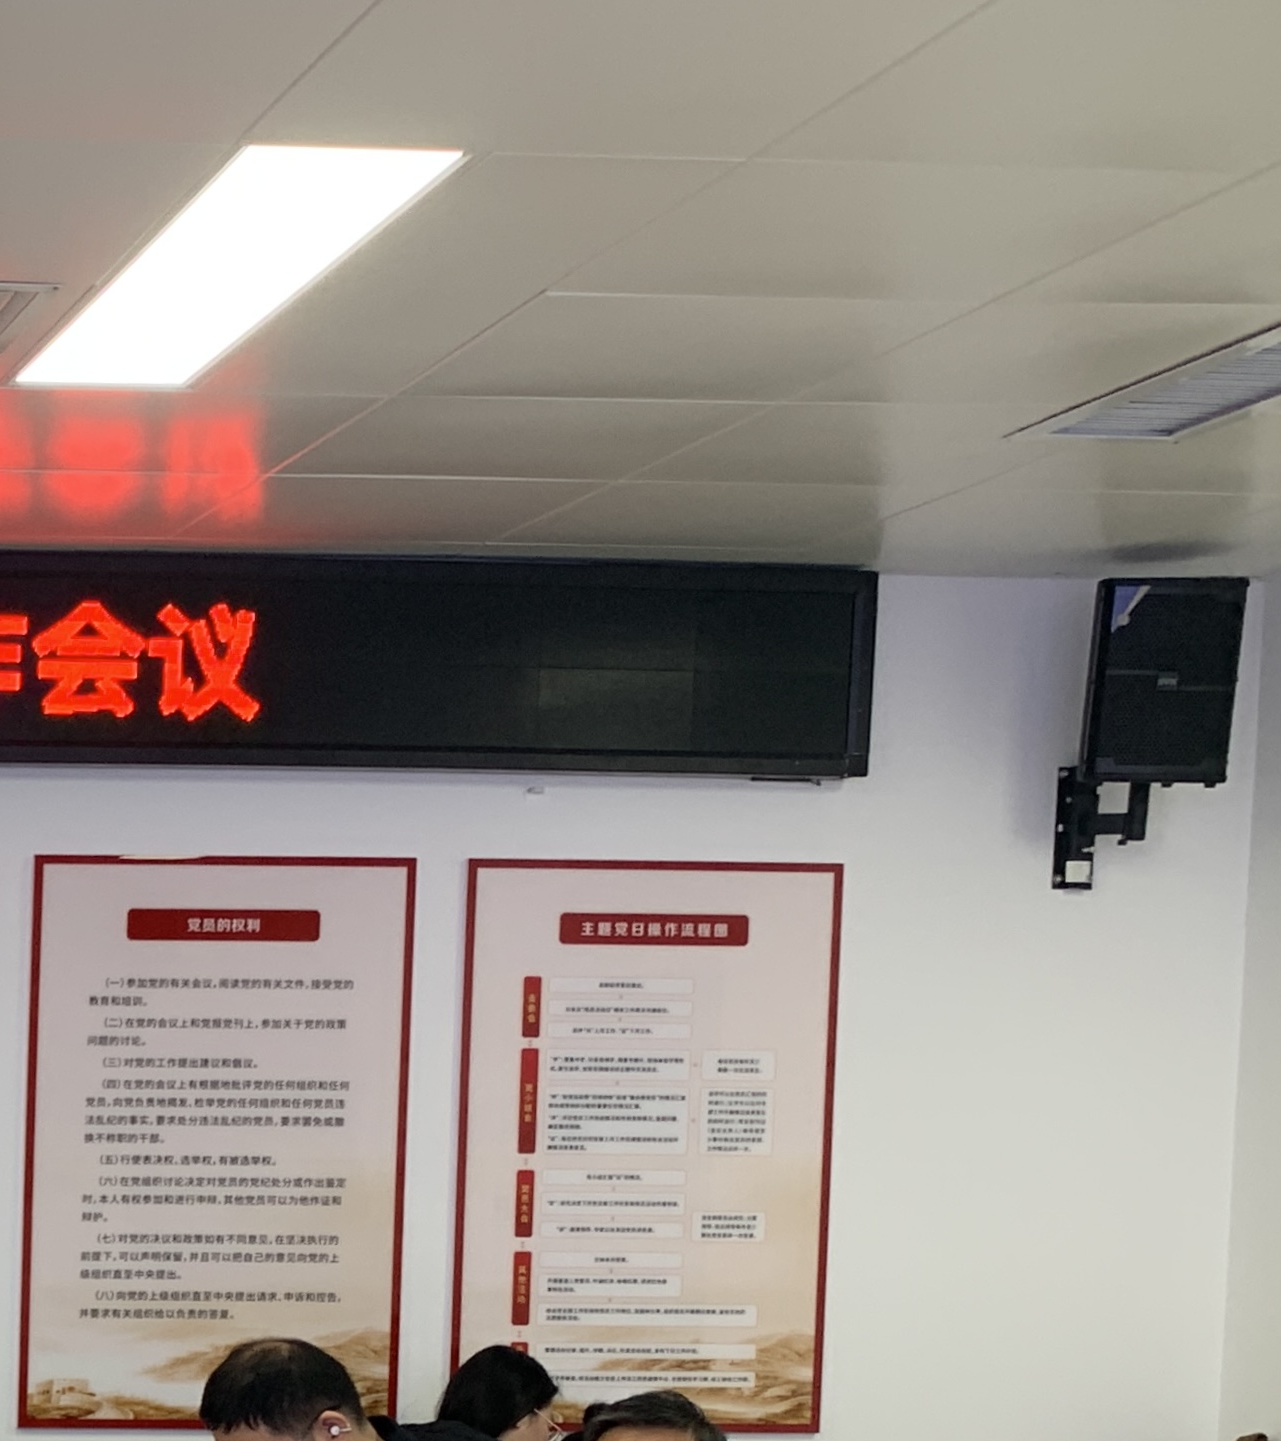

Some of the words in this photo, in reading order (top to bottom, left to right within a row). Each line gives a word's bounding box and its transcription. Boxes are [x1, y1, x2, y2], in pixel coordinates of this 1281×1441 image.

[187, 918, 260, 933] 党员的权利
